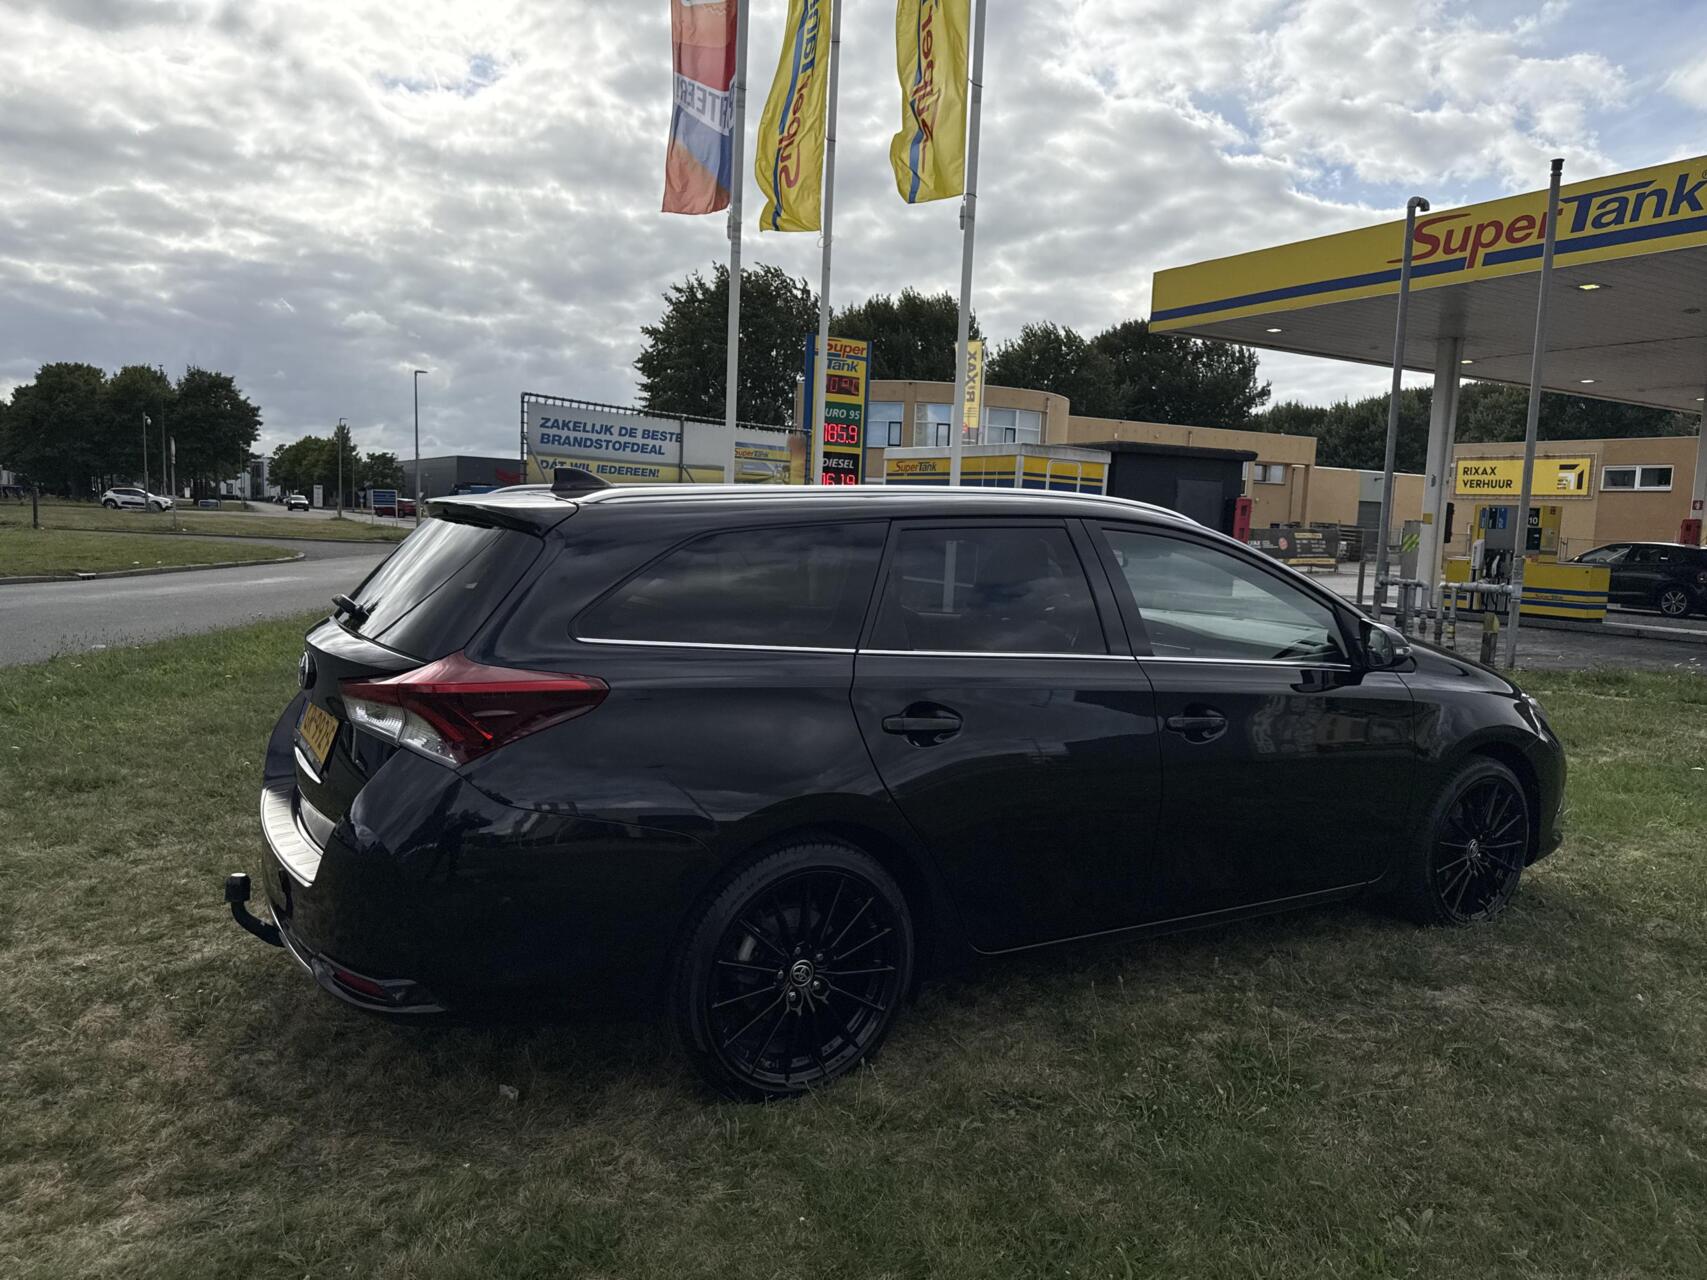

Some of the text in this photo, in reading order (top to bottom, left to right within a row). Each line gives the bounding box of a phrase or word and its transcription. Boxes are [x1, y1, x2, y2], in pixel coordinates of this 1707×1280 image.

[825, 407, 860, 420] URO 95
[539, 416, 682, 444] ZAKELIJK DE BESTE
[824, 422, 858, 444] 185.9
[539, 433, 666, 456] BRANDSTOFDEAL
[822, 458, 855, 469] DIESEL
[893, 460, 937, 472] SuperTank
[596, 464, 660, 478] IEDEREEN!
[1462, 466, 1497, 476] RIXAX
[1462, 479, 1513, 489] VERHUUR
